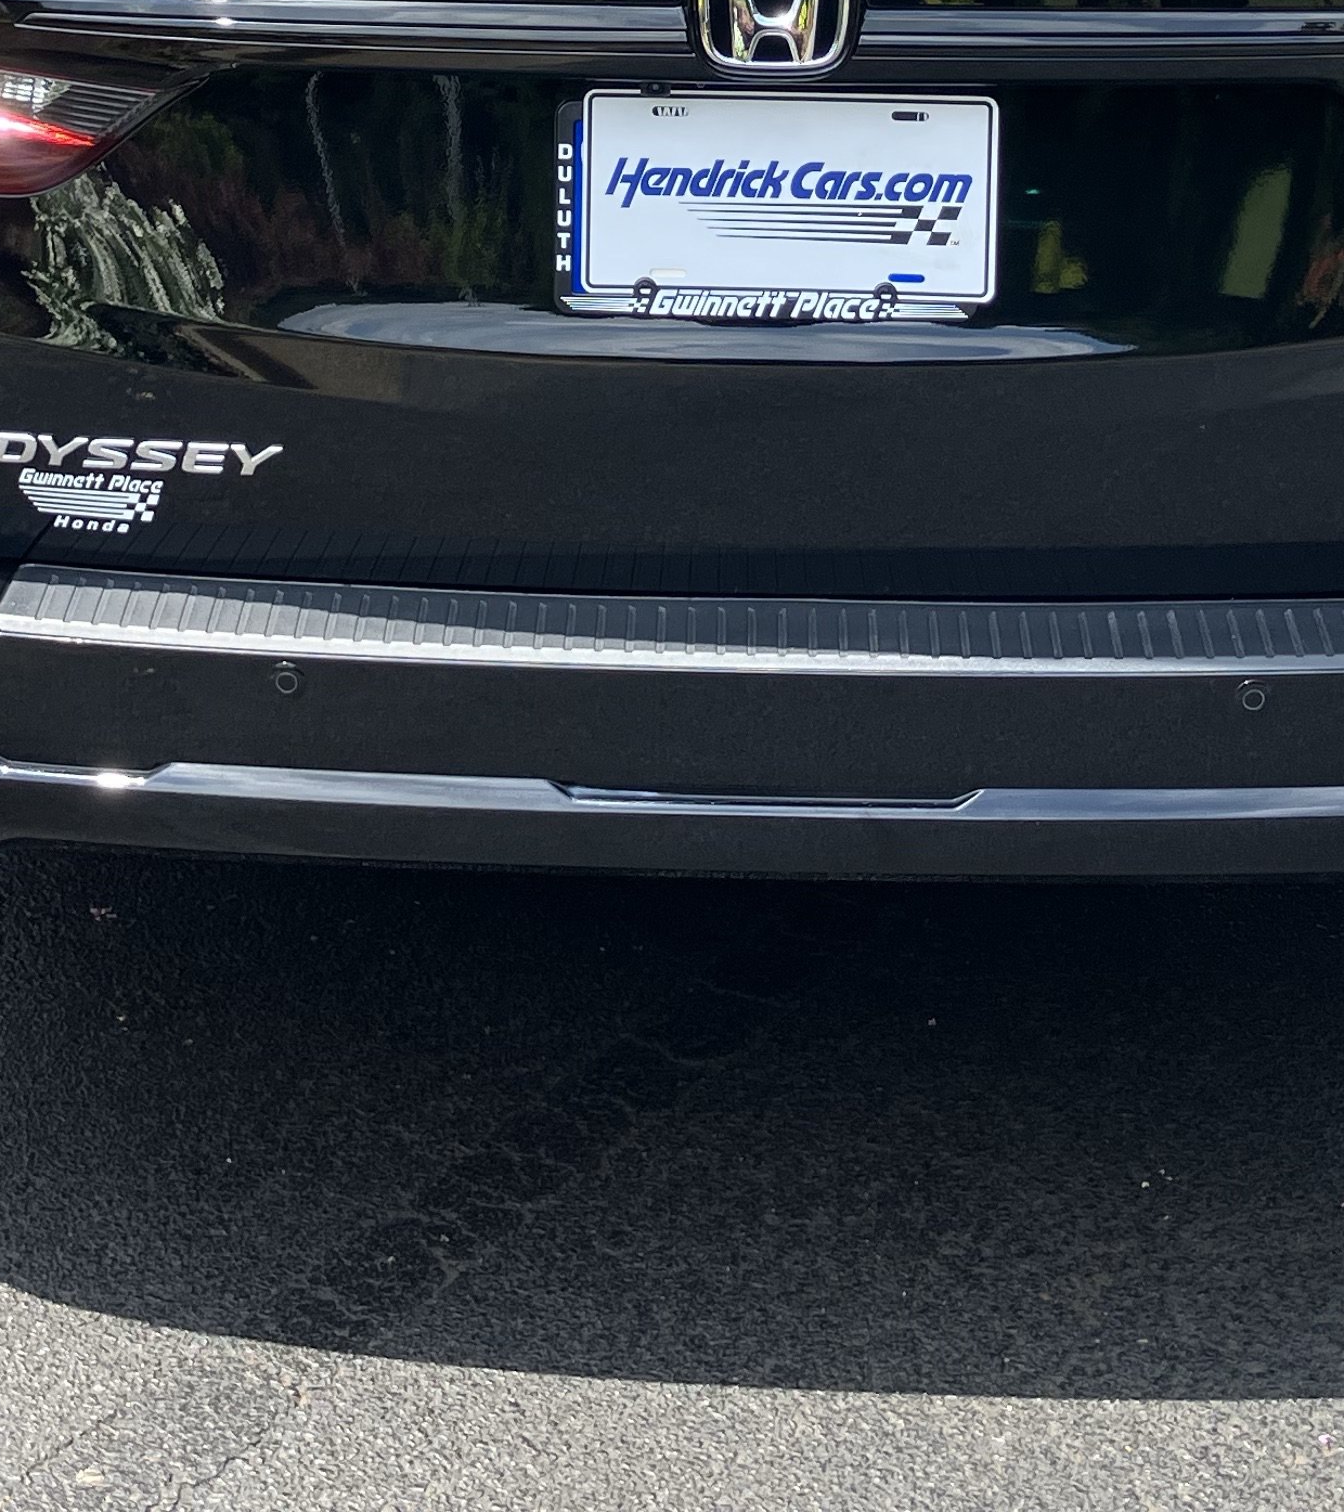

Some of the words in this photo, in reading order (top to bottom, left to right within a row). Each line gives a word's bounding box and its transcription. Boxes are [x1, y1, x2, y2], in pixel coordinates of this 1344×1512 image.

[556, 143, 573, 272] DULUTH
[649, 289, 789, 318] Gwinnett
[789, 291, 881, 320] Place
[18, 467, 105, 489] Gwinnett
[107, 474, 164, 494] Place
[53, 514, 130, 534] Honda
